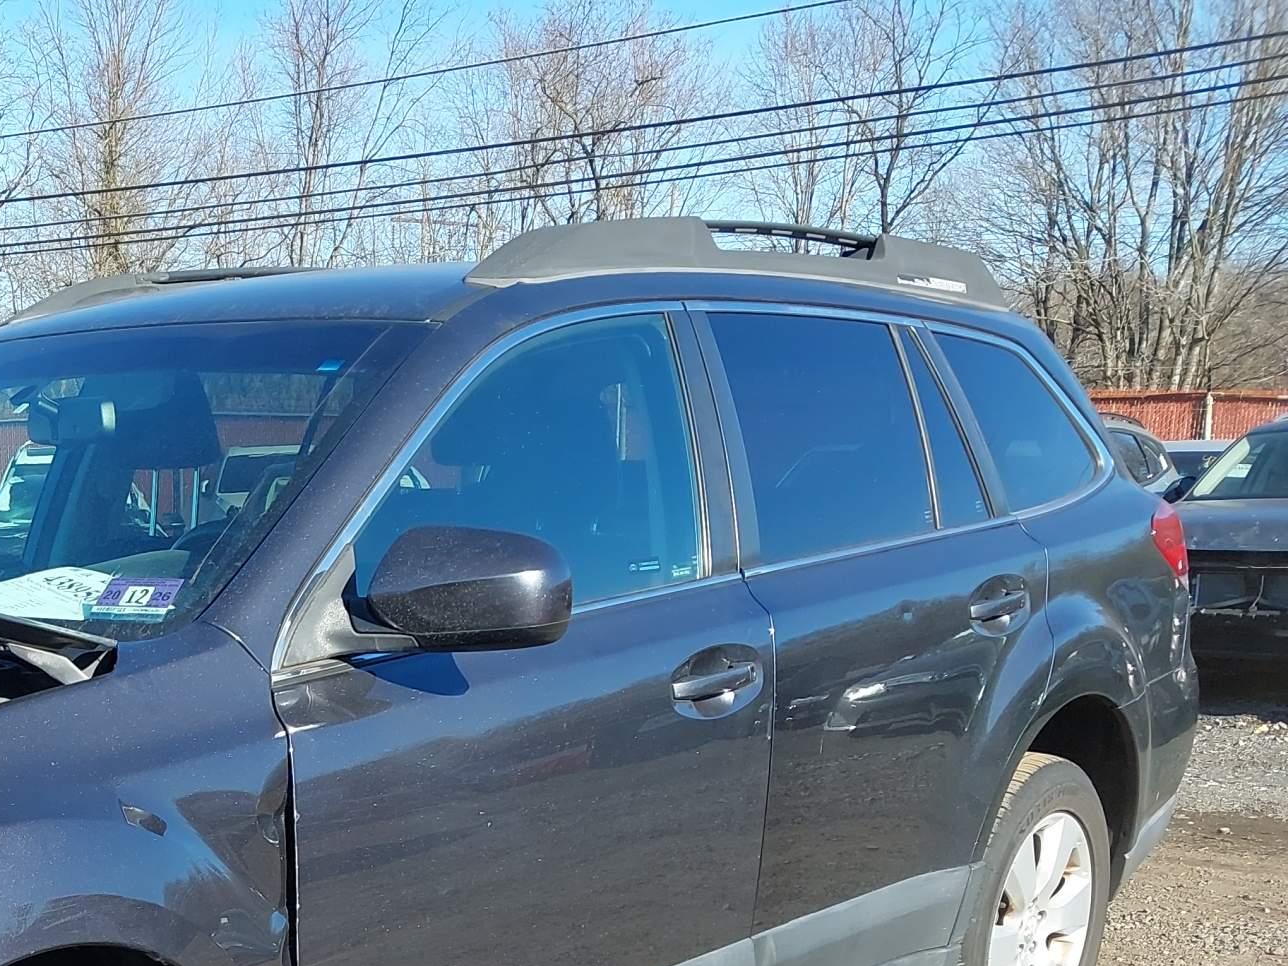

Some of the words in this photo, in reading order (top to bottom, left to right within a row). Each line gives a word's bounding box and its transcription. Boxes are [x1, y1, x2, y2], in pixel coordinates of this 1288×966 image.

[103, 590, 121, 600] 20
[125, 588, 149, 604] 12
[152, 591, 172, 601] 26
